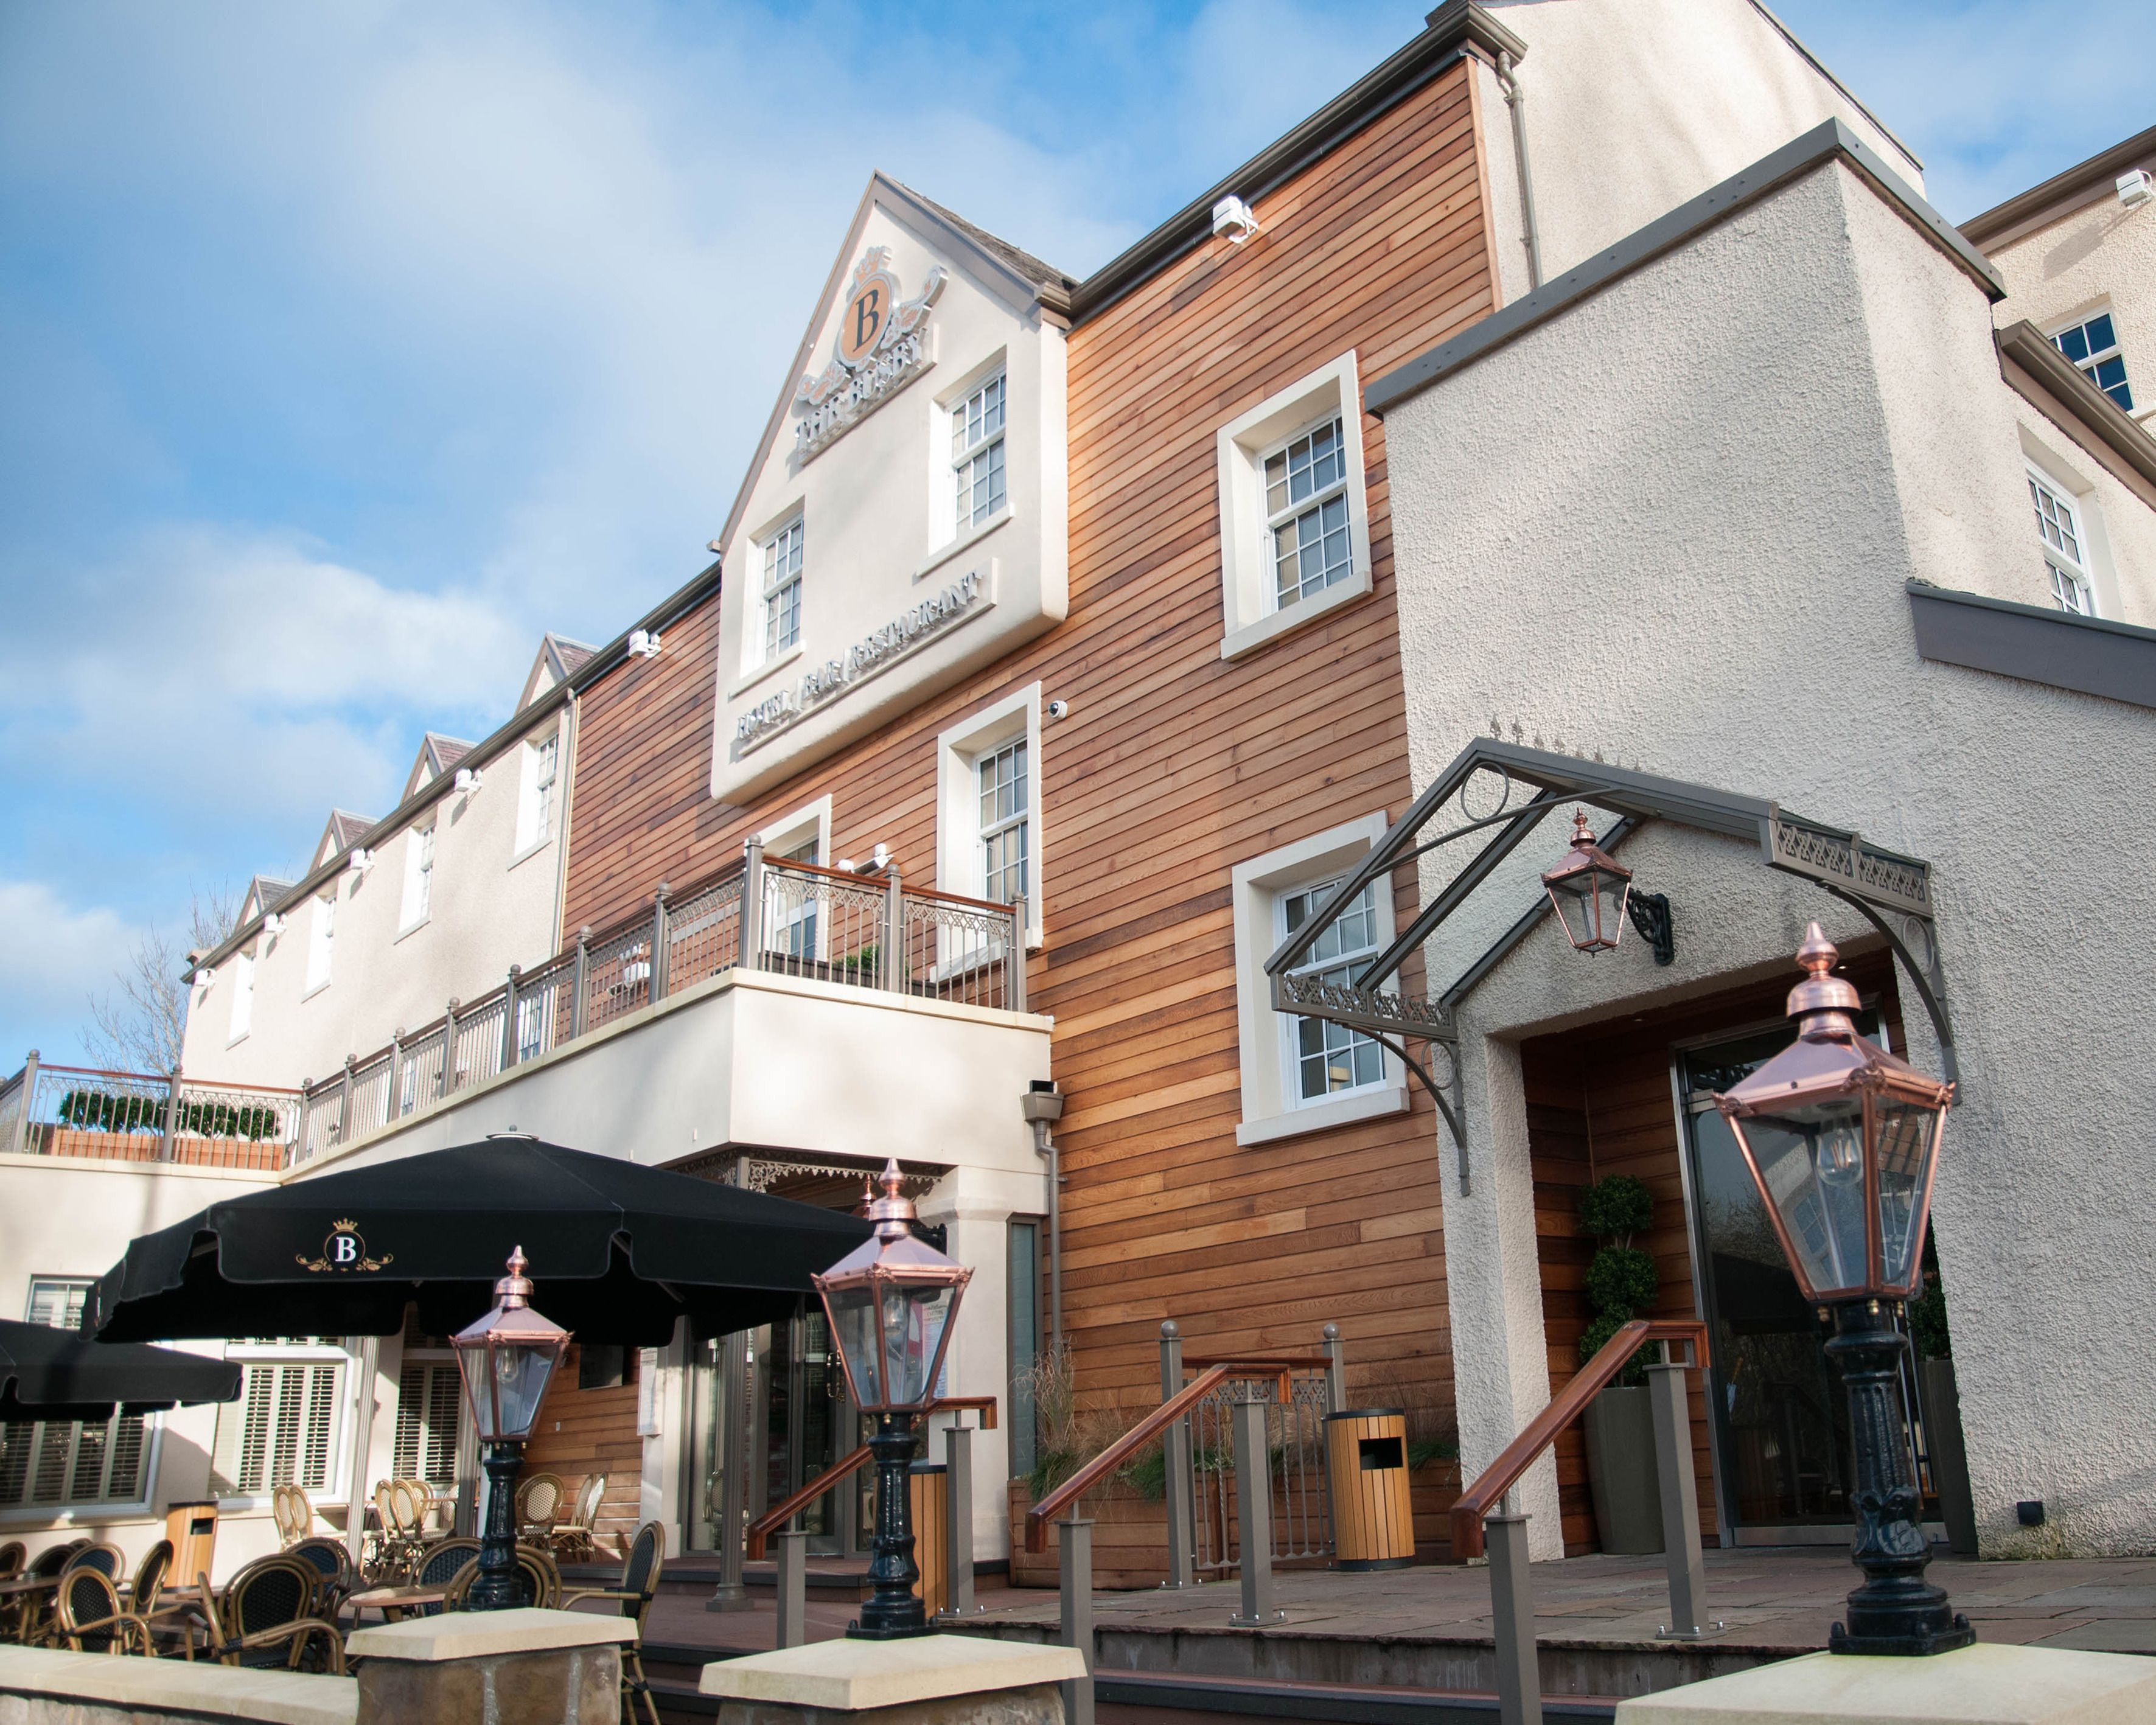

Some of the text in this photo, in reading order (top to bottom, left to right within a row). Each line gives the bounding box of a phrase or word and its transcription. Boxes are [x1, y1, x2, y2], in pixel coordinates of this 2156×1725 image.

[853, 289, 879, 352] B
[795, 327, 927, 450] THE BUSBY
[738, 570, 983, 739] HOTEL BAR RESTAURANT
[335, 1236, 357, 1262] B
